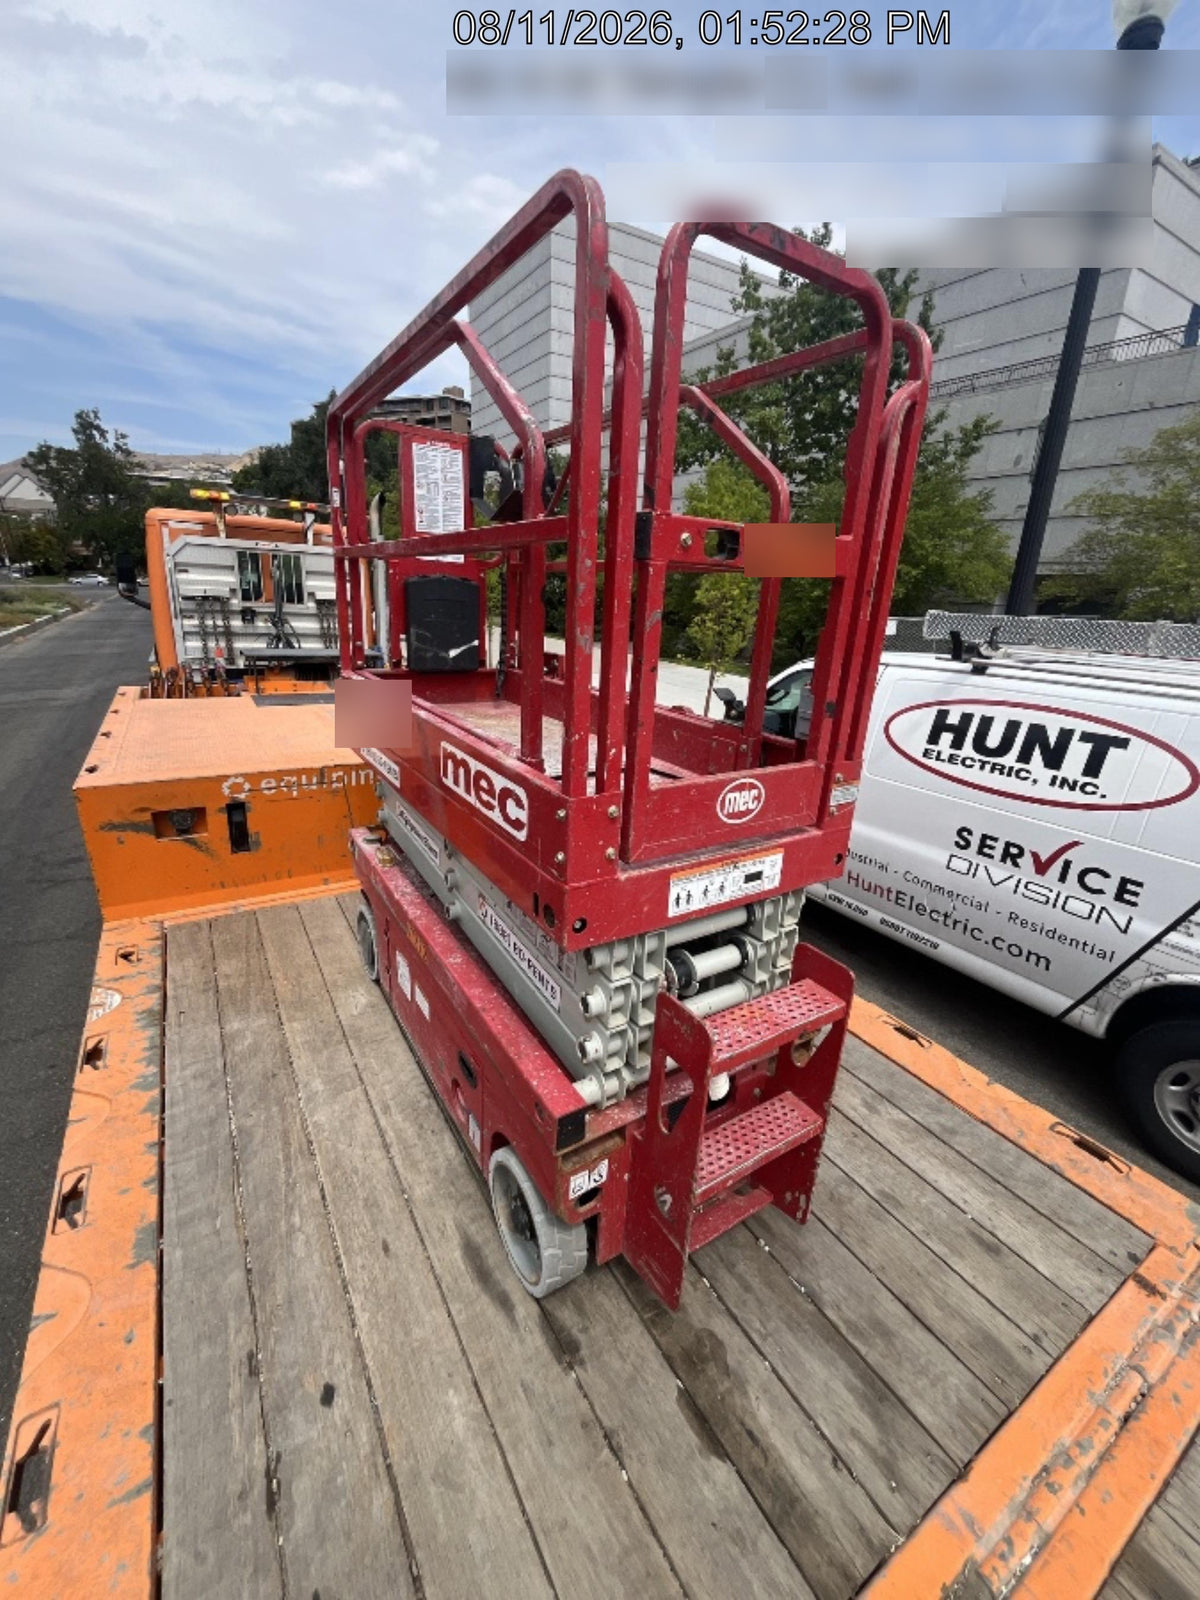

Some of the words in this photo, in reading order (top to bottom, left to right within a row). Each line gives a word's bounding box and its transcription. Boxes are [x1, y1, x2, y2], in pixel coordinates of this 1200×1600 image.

[922, 747, 1039, 785] ELECTRIC,
[1048, 774, 1107, 799] INC.
[926, 708, 1130, 780] HUNT
[442, 748, 529, 833] mec
[722, 788, 759, 815] mec
[946, 854, 1134, 935] DIVISION
[953, 826, 1145, 908] SERVICE
[846, 869, 1053, 972] HuntElectric.com
[902, 870, 990, 913] Commercial
[1007, 911, 1116, 963] Residential
